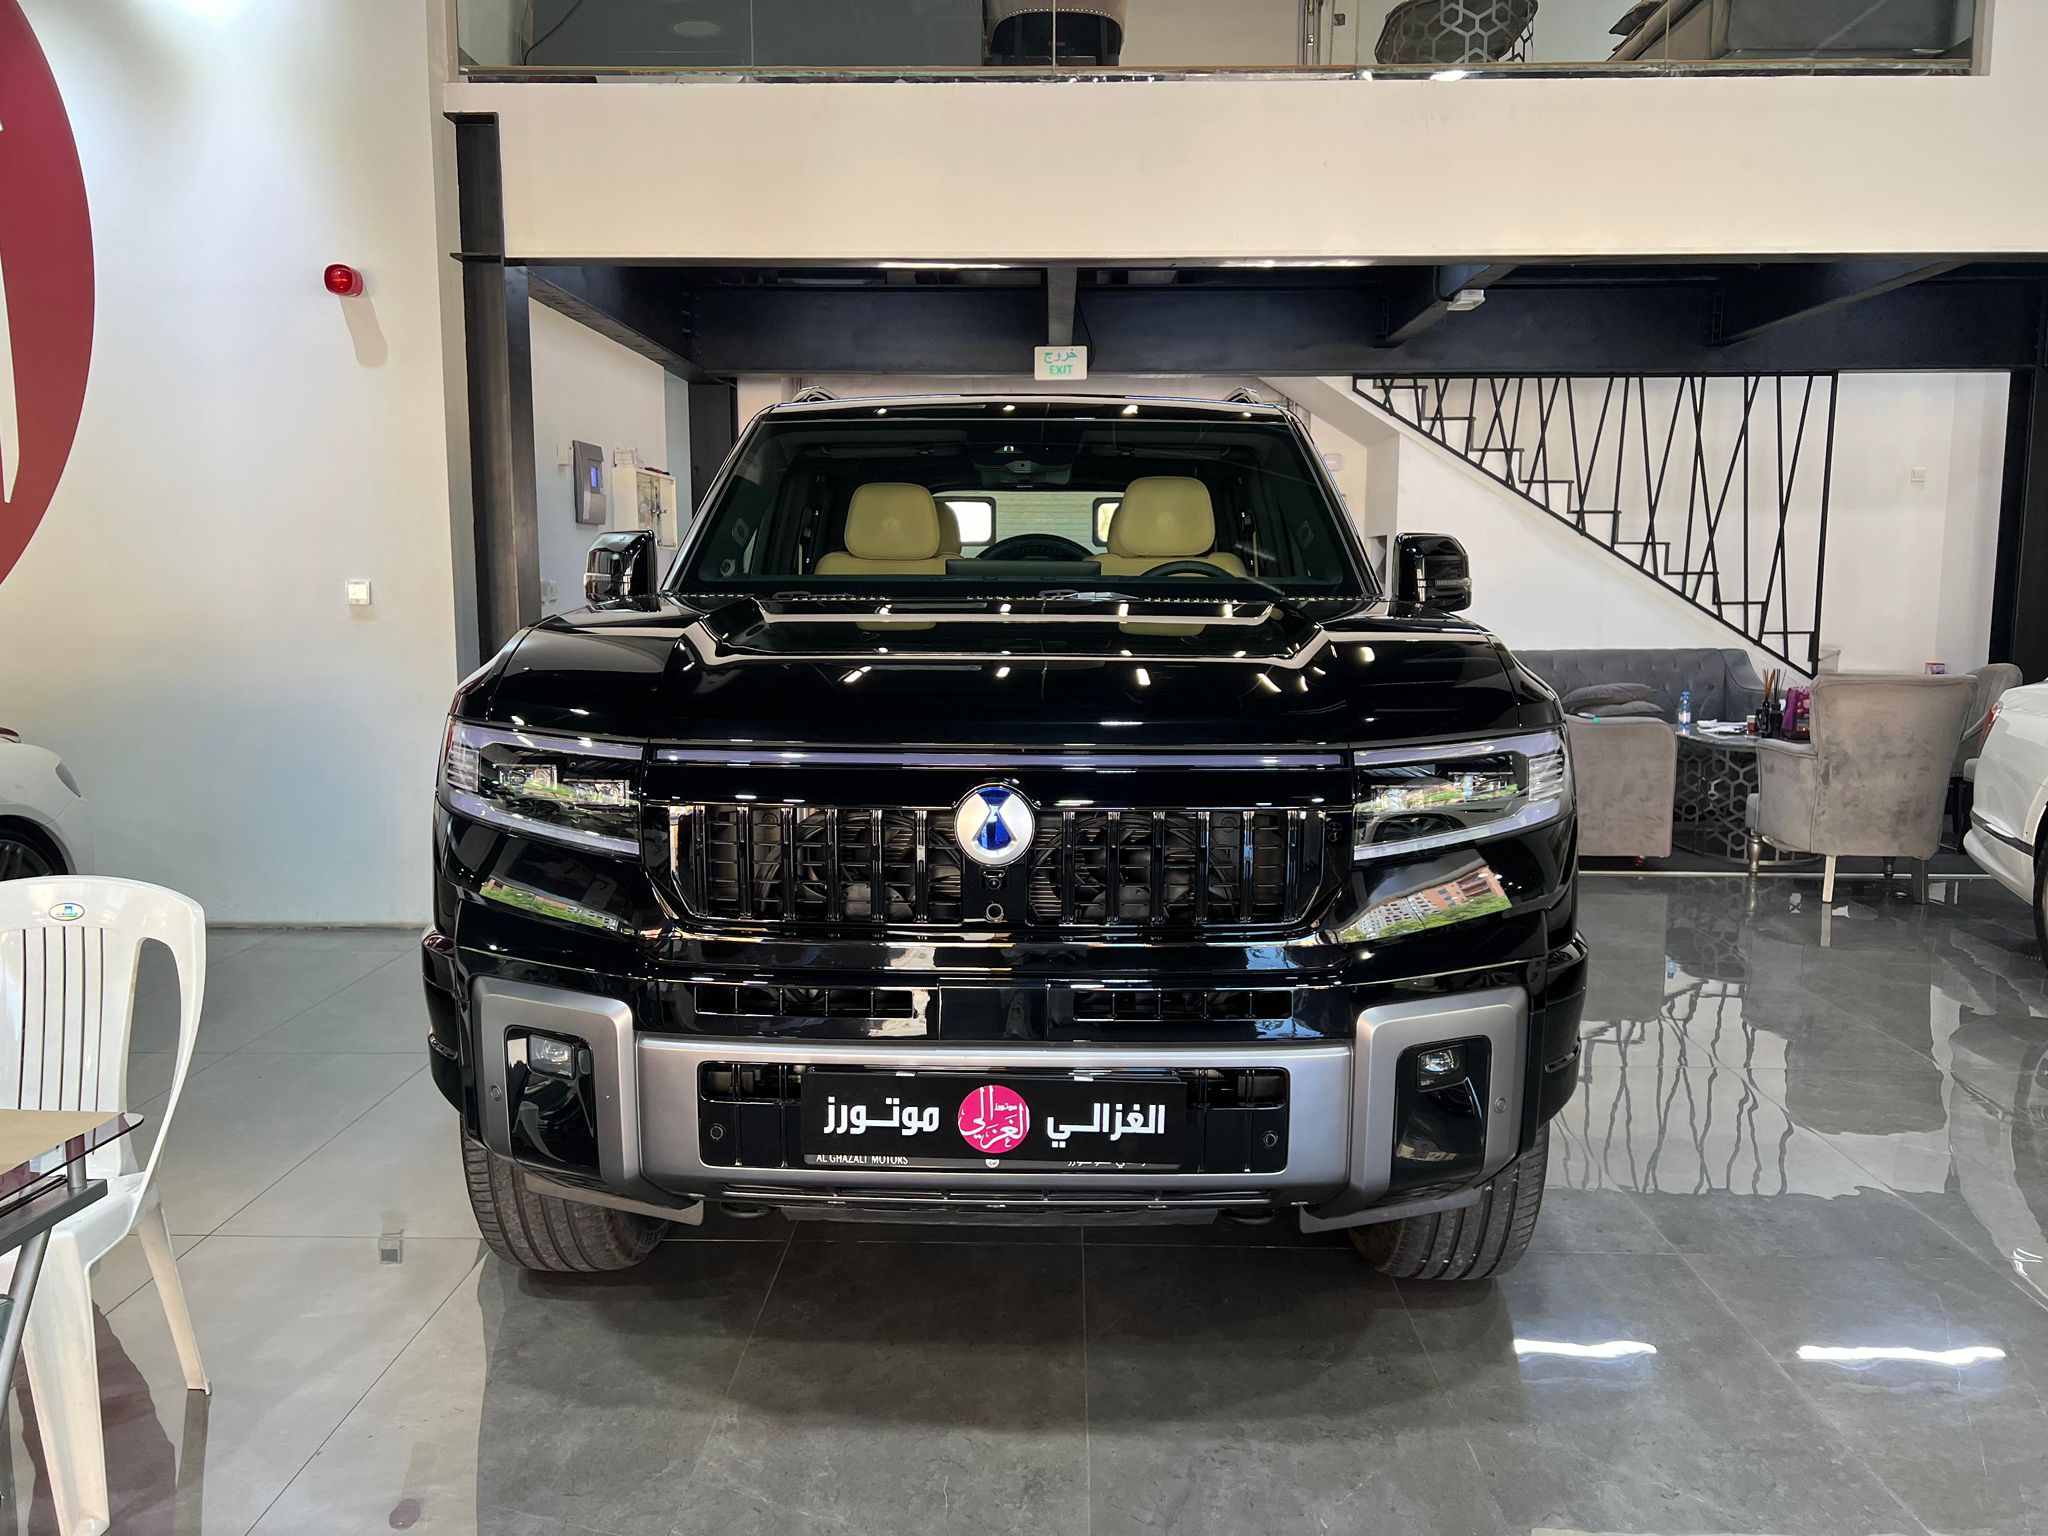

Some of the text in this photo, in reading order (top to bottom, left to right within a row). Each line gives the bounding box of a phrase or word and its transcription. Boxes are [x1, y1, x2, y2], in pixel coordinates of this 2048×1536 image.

[1044, 348, 1078, 364] خروج
[1049, 365, 1074, 376] EXIT
[823, 1096, 1165, 1149] الغزالي موتورز
[816, 1154, 828, 1163] AL
